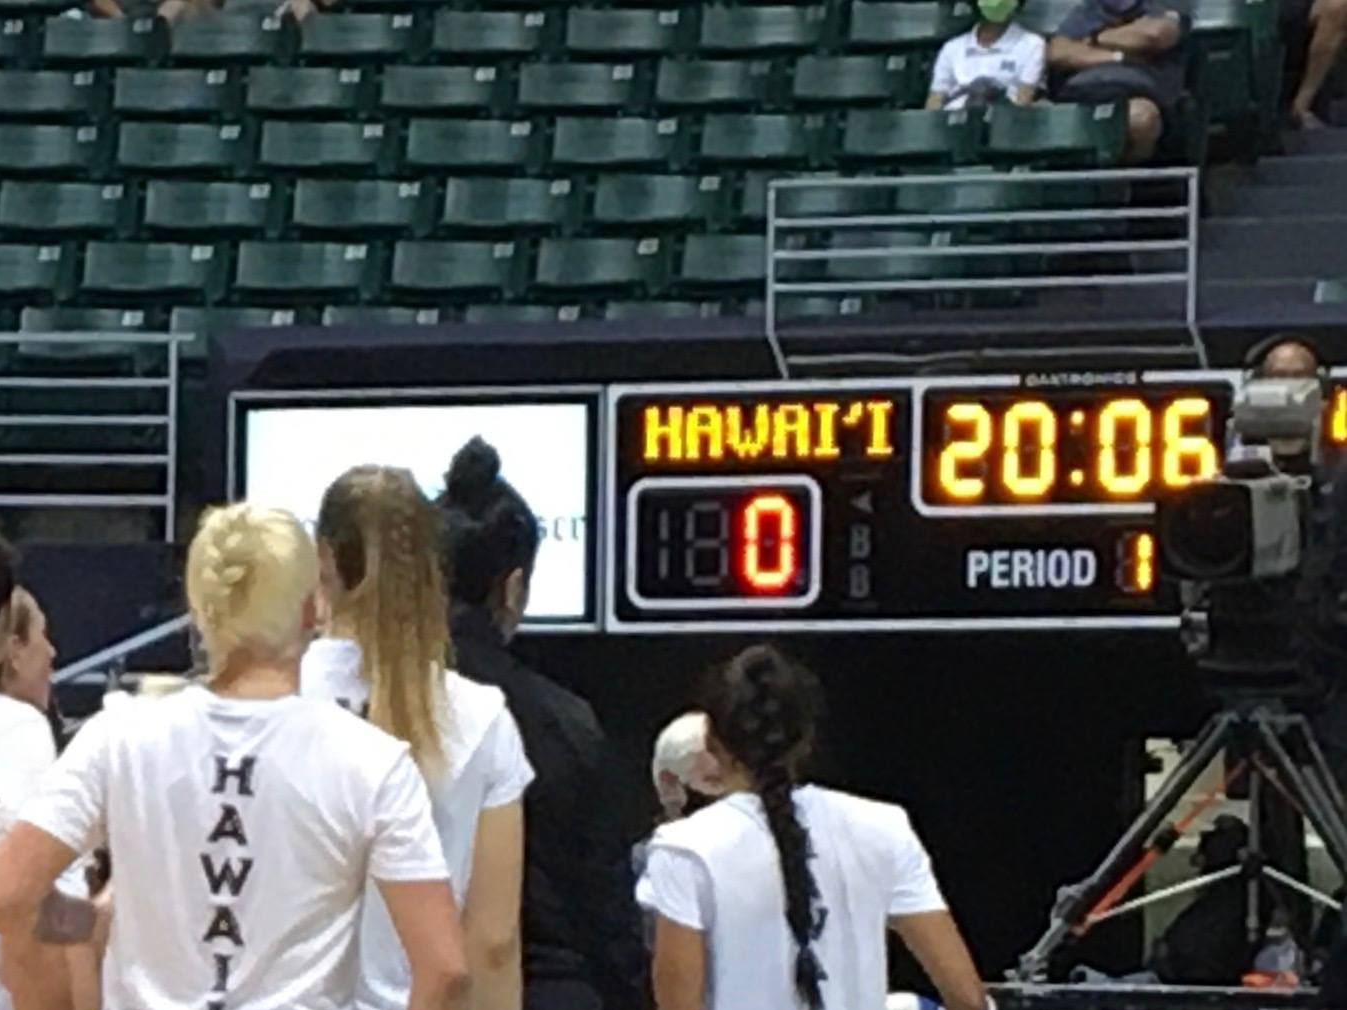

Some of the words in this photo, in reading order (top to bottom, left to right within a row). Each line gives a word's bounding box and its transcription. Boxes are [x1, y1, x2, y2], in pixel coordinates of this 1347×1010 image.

[939, 398, 1220, 497] 20:06
[744, 494, 796, 588] 0
[966, 549, 1097, 589] PERIOD
[1136, 532, 1153, 592] 1
